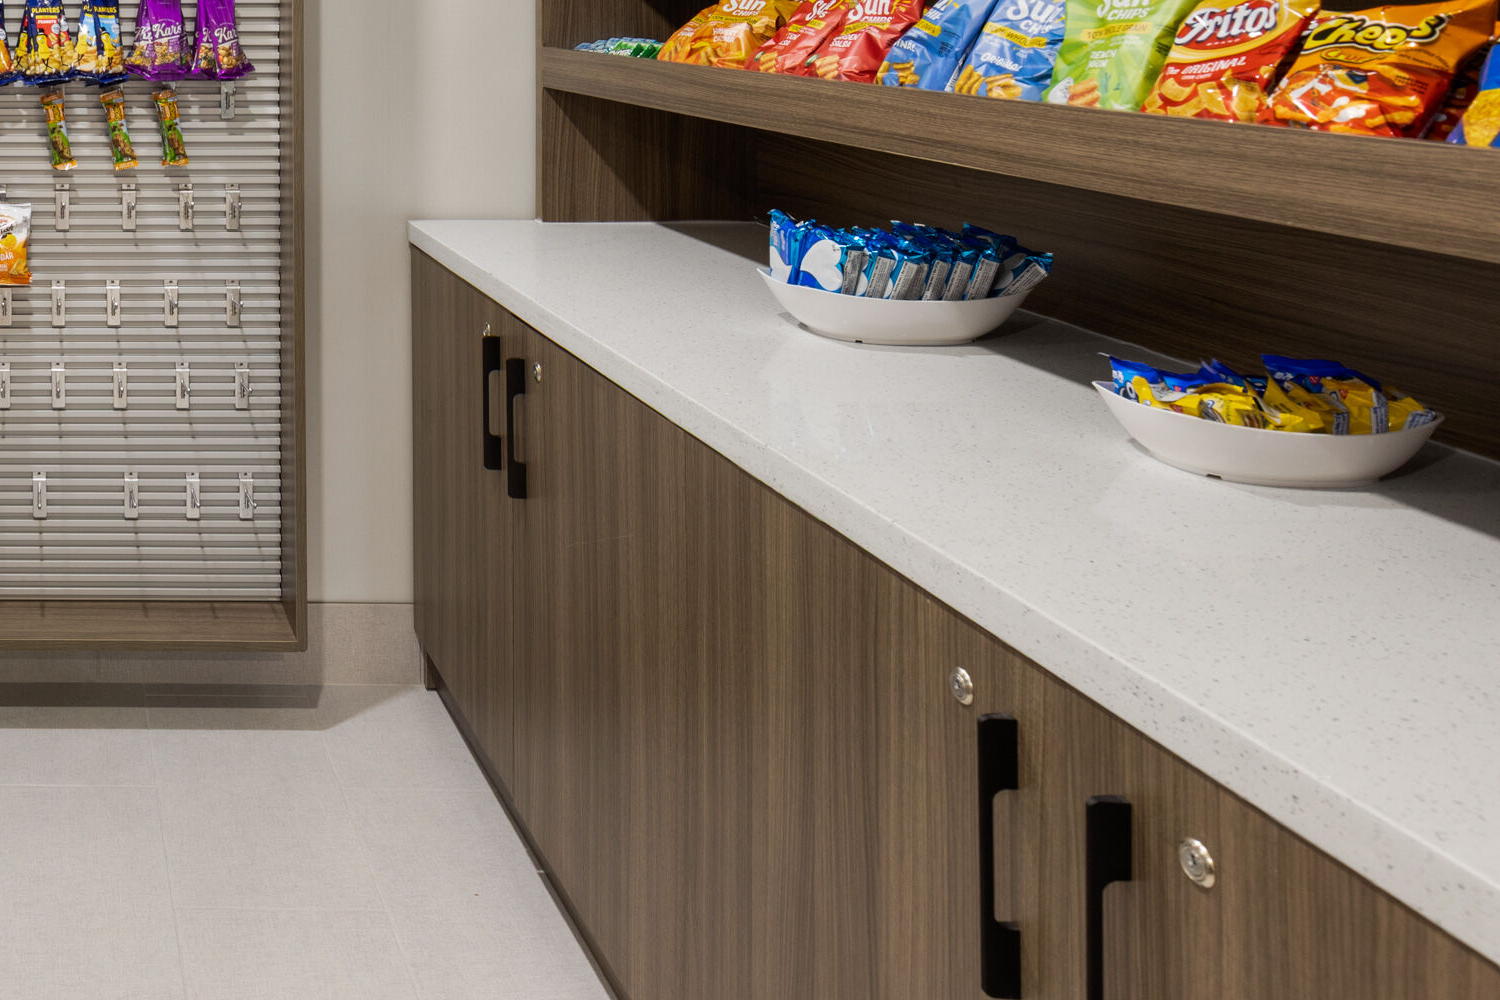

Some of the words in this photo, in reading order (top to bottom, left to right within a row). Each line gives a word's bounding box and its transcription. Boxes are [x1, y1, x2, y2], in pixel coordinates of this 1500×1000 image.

[732, 9, 760, 17] CHIPS
[1107, 7, 1150, 21] CHIPS
[153, 21, 182, 39] Kar's
[1174, 2, 1280, 46] Fritos
[1166, 66, 1180, 76] The
[1181, 56, 1247, 75] ORIGINAL
